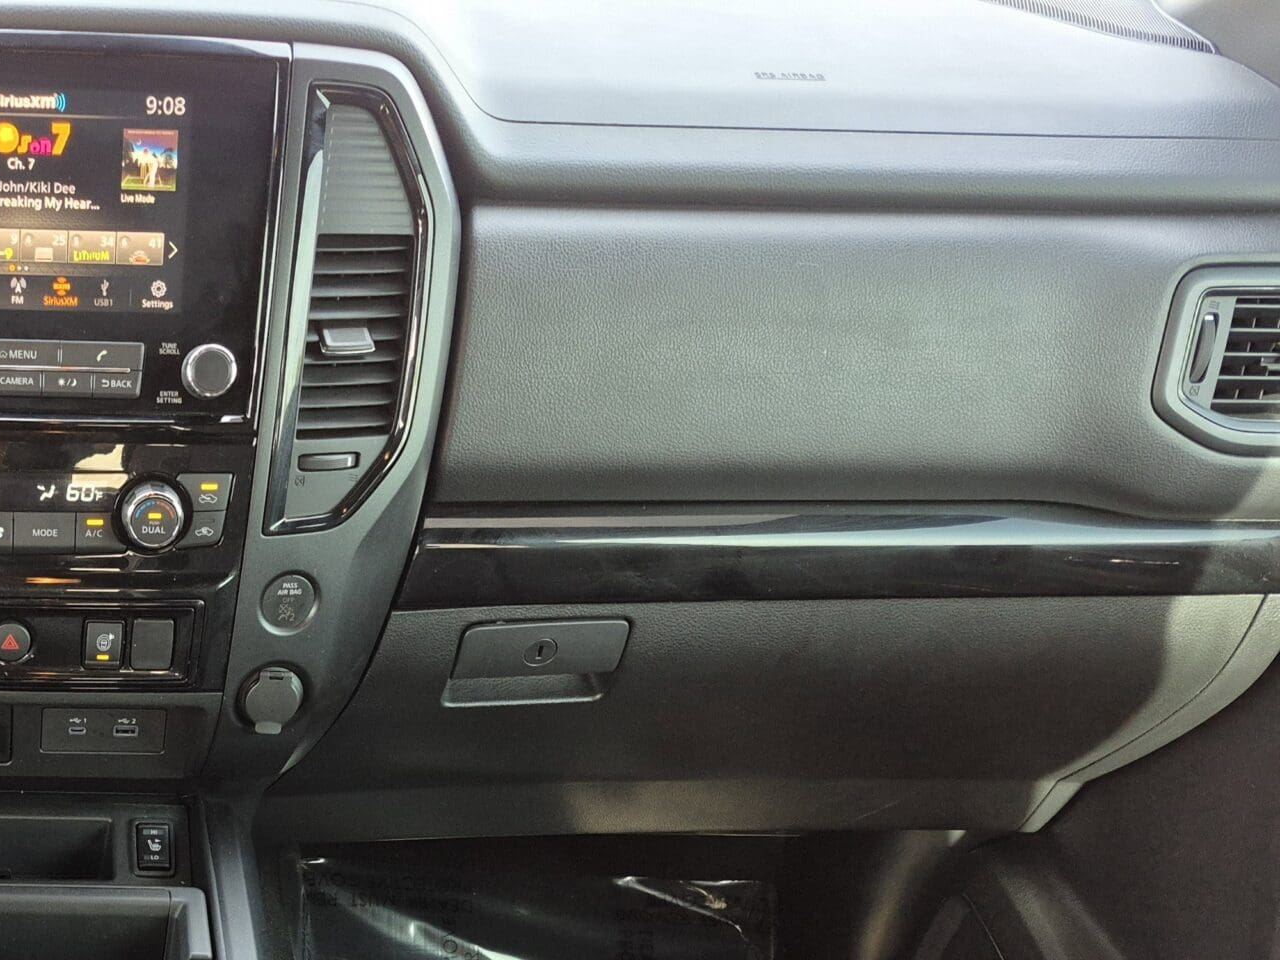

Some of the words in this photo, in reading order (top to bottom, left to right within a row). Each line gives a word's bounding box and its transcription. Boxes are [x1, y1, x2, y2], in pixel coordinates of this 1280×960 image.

[145, 96, 187, 115] 9:08
[7, 157, 26, 171] Ch.
[28, 158, 36, 170] 7
[54, 183, 76, 195] Dee
[44, 196, 63, 211] My
[11, 295, 24, 305] FM
[141, 298, 174, 311] Settings
[161, 342, 178, 350] TUNE
[8, 350, 38, 360] MENU
[0, 376, 34, 386] CAMERA
[110, 379, 132, 389] BACK
[159, 390, 179, 398] ENTER
[32, 528, 58, 538] MODE
[84, 529, 103, 539] A/C
[141, 525, 166, 535] DUAL
[289, 588, 303, 596] BAG
